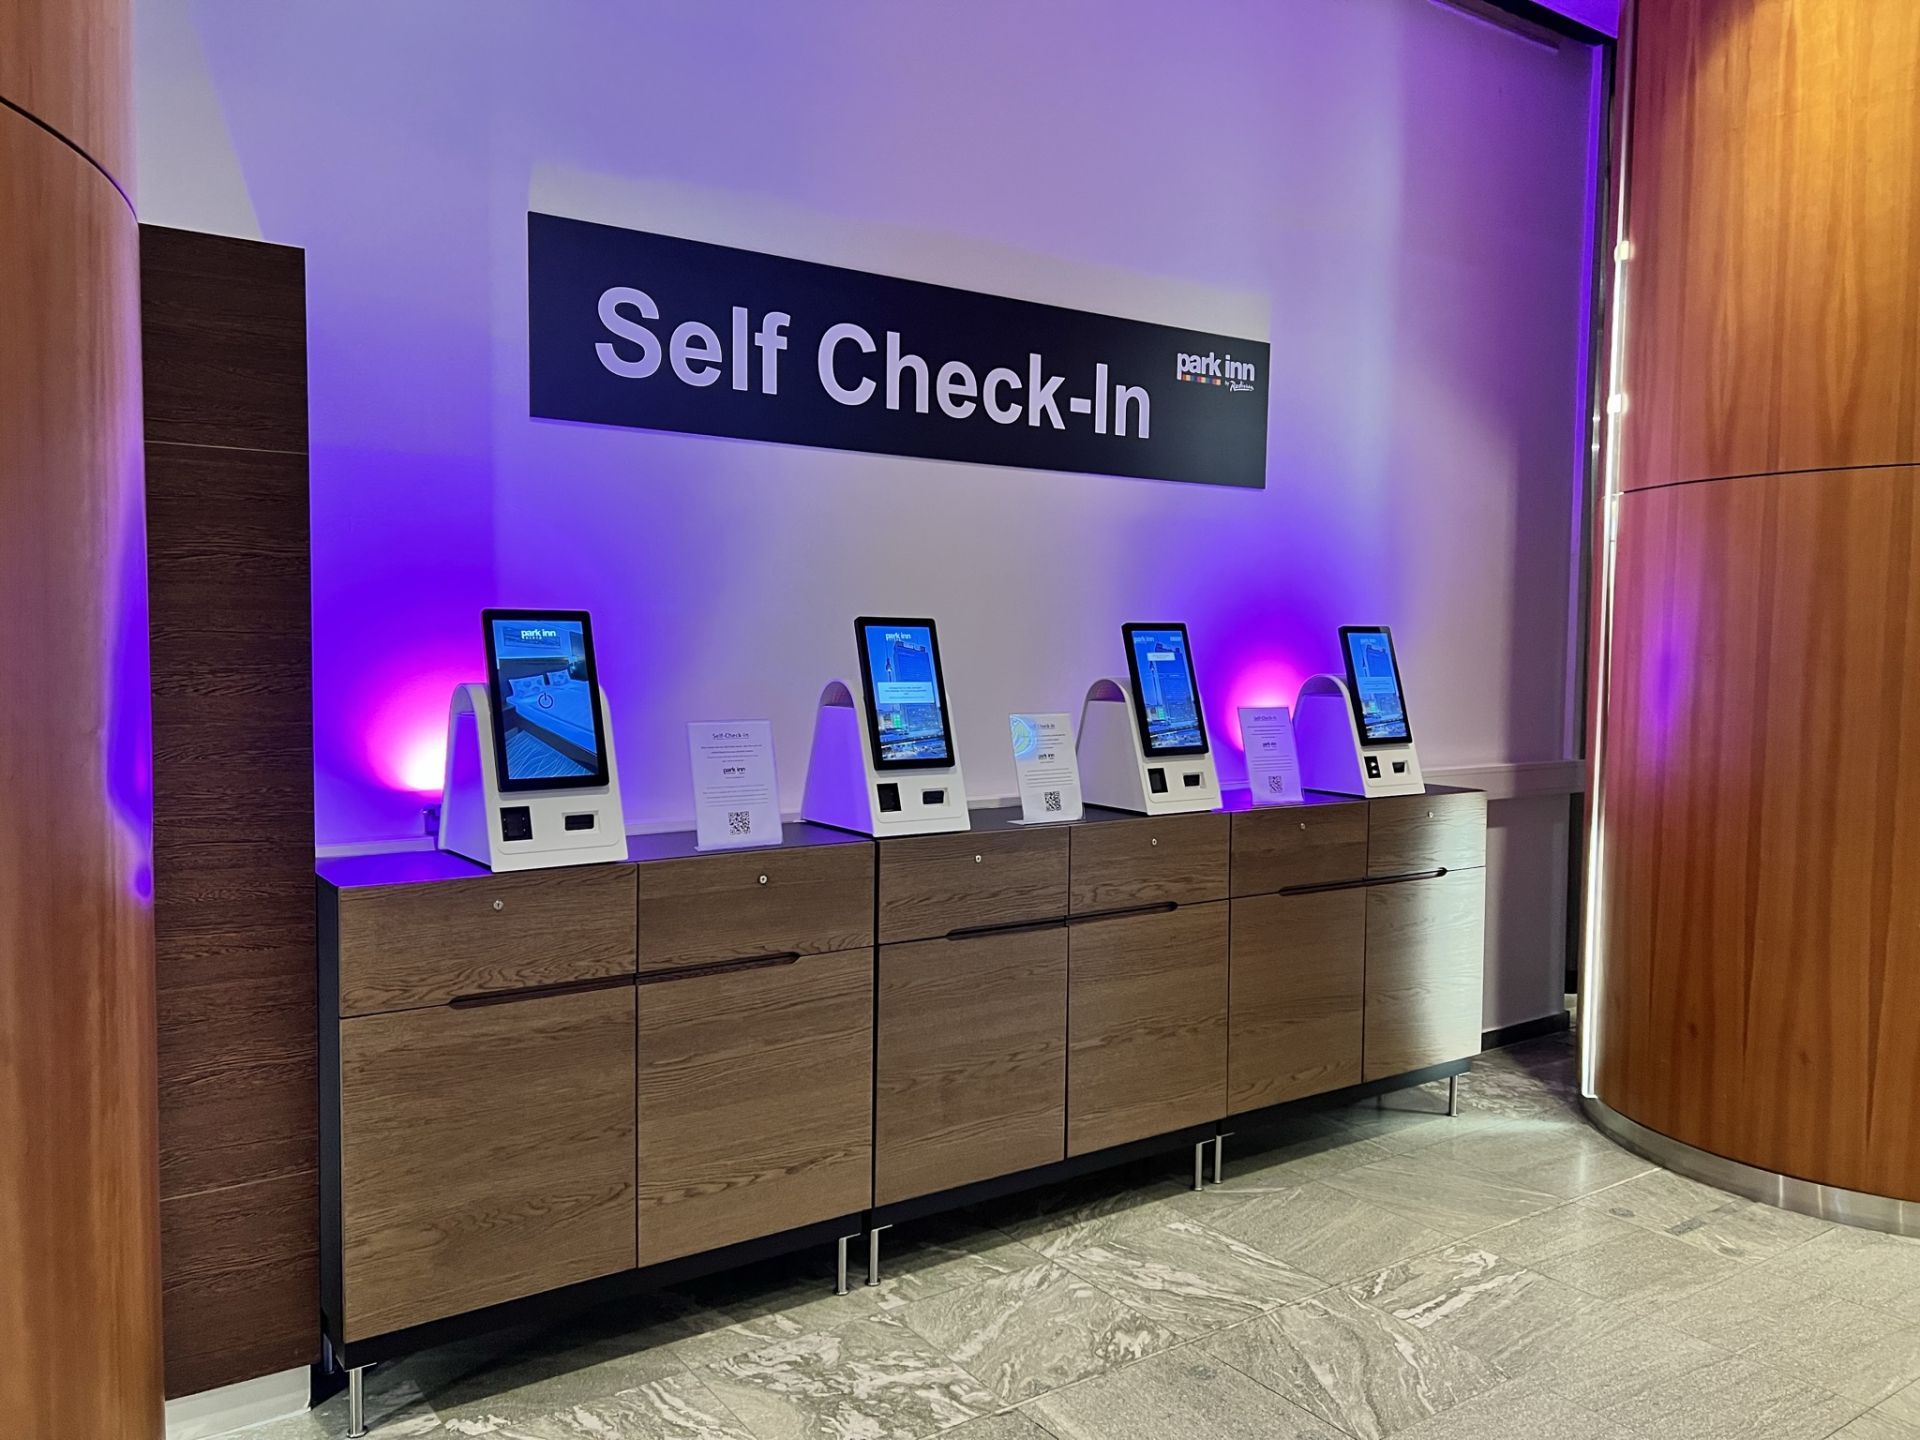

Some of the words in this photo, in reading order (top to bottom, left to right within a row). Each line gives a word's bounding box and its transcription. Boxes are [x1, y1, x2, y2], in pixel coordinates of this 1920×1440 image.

[595, 286, 791, 395] Self
[817, 323, 1150, 439] Check-In
[1176, 352, 1222, 380] park
[1224, 354, 1255, 381] inn
[520, 628, 542, 639] park
[542, 628, 557, 637] inn
